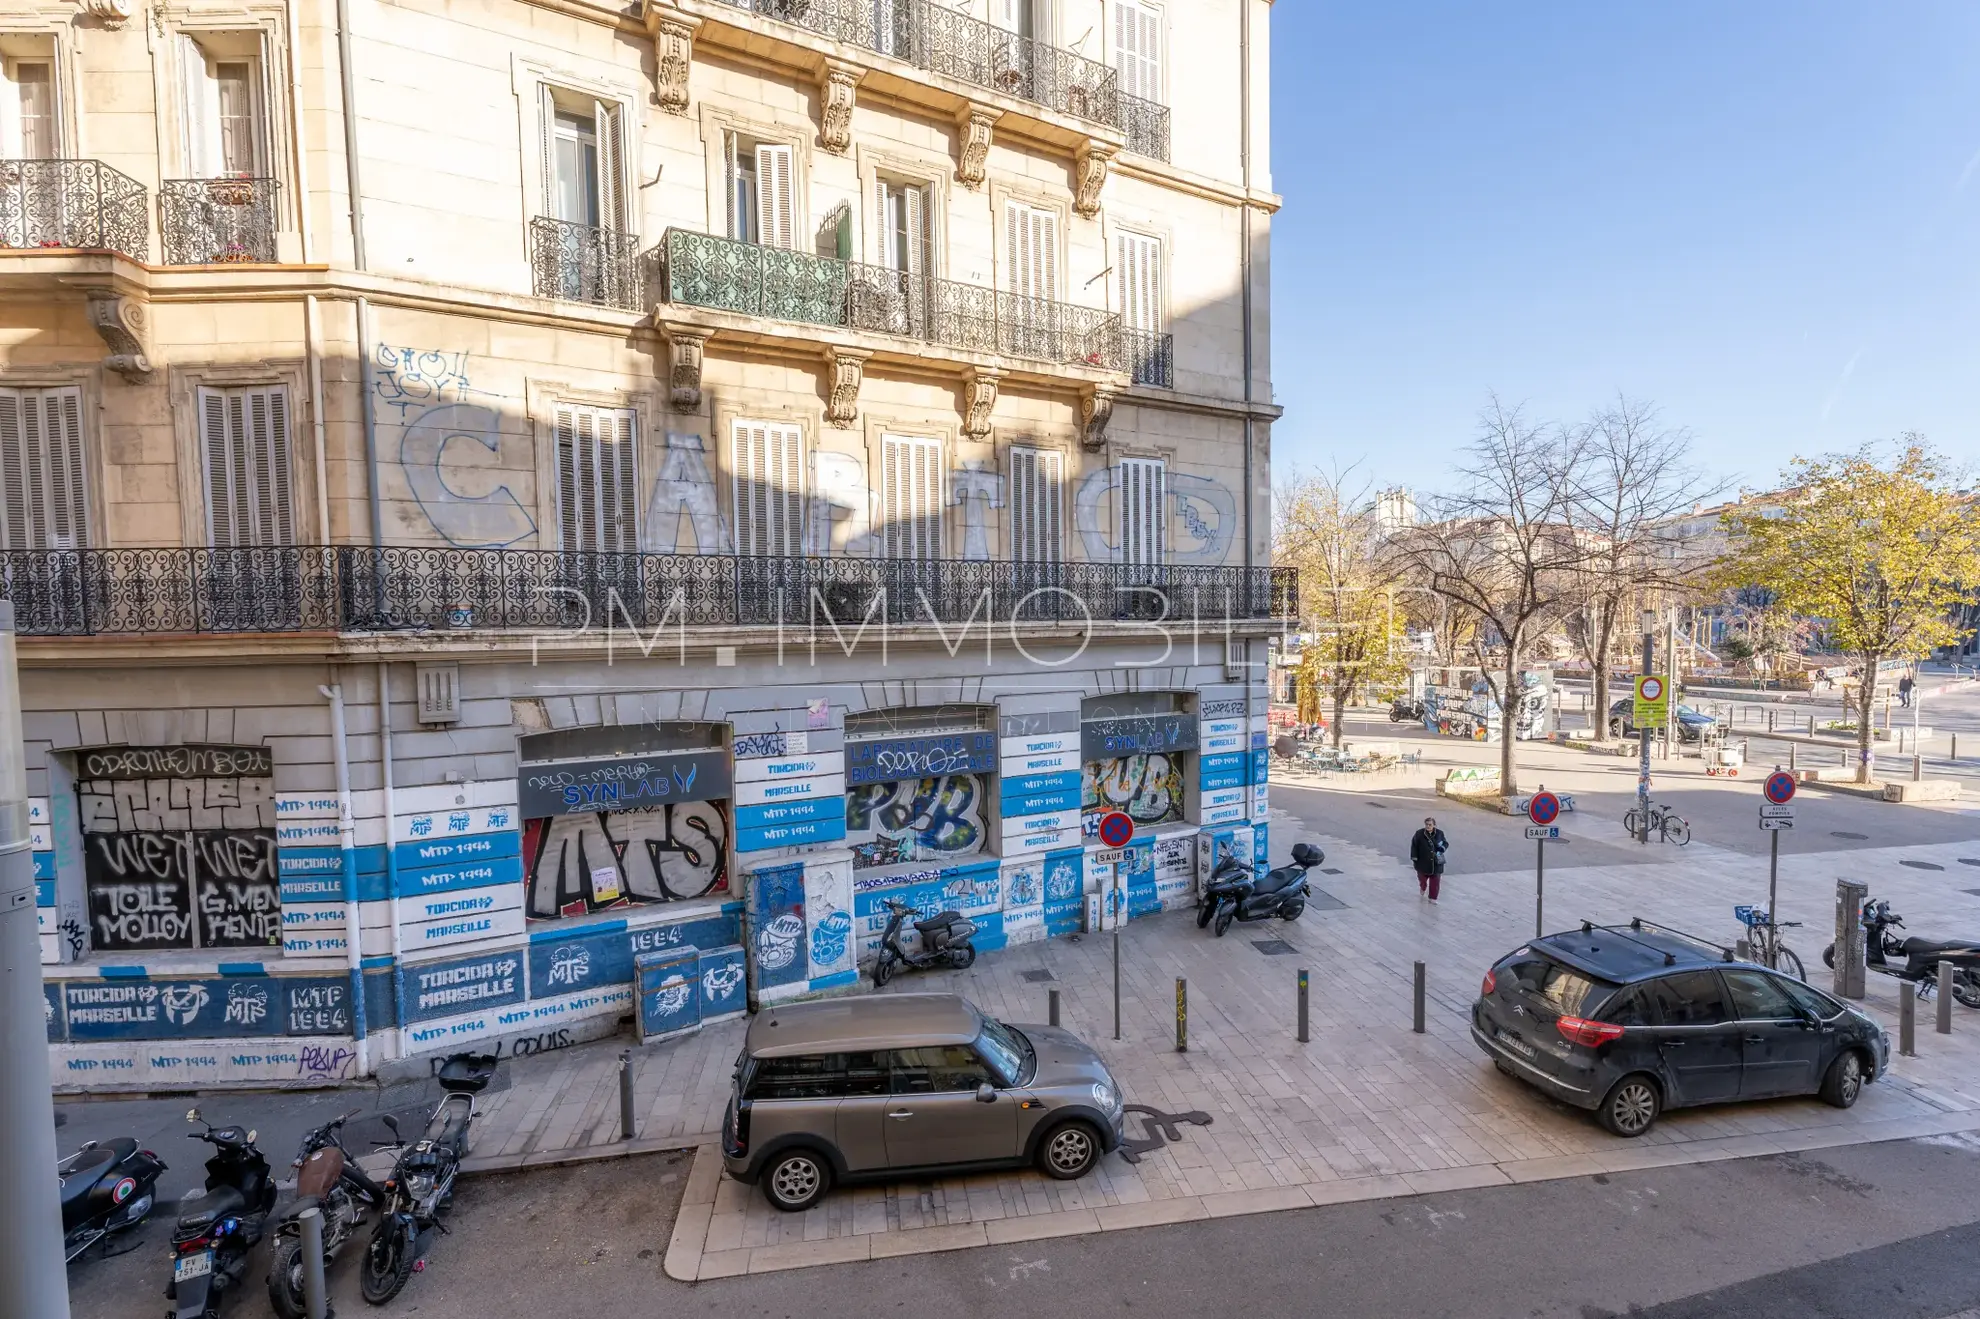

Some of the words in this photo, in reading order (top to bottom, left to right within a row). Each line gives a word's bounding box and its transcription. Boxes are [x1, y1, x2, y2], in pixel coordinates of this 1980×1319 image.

[851, 737, 963, 761] LABORATOIRE
[975, 735, 994, 750] DE
[1028, 758, 1062, 769] MARSEILLE
[563, 777, 669, 804] SYNLAB
[765, 784, 812, 797] MARSEILLE
[276, 799, 305, 812] MTP
[307, 799, 339, 810] 1994
[764, 808, 787, 820] MTP
[790, 805, 814, 816] 1994
[278, 827, 307, 839] MTP
[307, 826, 340, 838] 1994
[764, 828, 788, 840] MTP
[791, 825, 815, 837] 1994
[419, 846, 454, 858] MTP
[456, 841, 491, 854] 1994
[1100, 853, 1121, 862] SAUF
[280, 857, 328, 870] TORCIDA
[421, 874, 455, 886] MTP
[458, 867, 493, 880] 1994
[281, 880, 341, 894] MARSEILLE
[425, 899, 478, 916] TORCIDA
[281, 912, 311, 924] MTP
[313, 910, 346, 921] 1994
[98, 912, 191, 943] MOLLOY
[426, 919, 491, 939] MARSEILLE
[283, 939, 313, 951] MTP
[315, 938, 348, 950] 1994
[419, 962, 494, 989] TORCIDA
[67, 986, 137, 1004] TORCIDA
[291, 985, 344, 1009] MTP
[418, 977, 515, 1010] MARSEILLE
[569, 998, 599, 1012] MTP
[603, 991, 633, 1005] 1994
[69, 1005, 158, 1024] MARSEILLE
[289, 1008, 348, 1030] 1994
[498, 1009, 531, 1025] MTP
[534, 1003, 565, 1018] 1994
[412, 1027, 447, 1042] MTP
[450, 1020, 486, 1034] 1994
[67, 1058, 98, 1070] MTP
[101, 1058, 134, 1070] 1994
[151, 1055, 182, 1069] MTP
[184, 1055, 217, 1067] 1994
[231, 1053, 262, 1066] MTP
[264, 1053, 297, 1065] 1994
